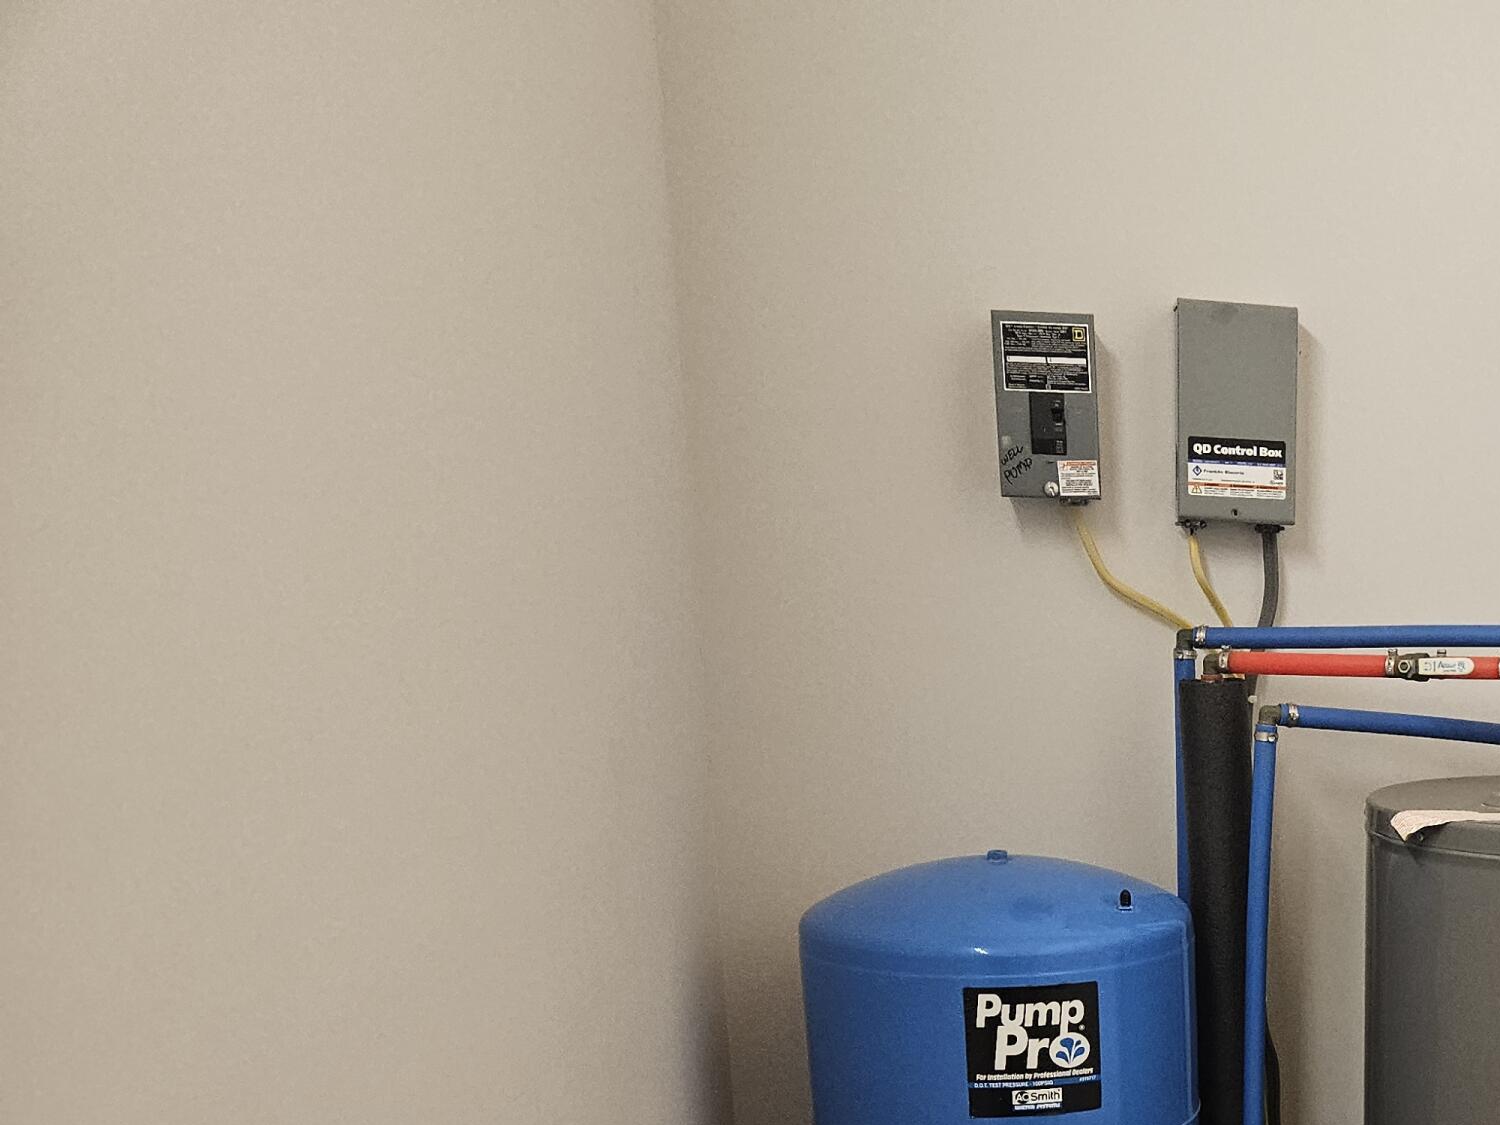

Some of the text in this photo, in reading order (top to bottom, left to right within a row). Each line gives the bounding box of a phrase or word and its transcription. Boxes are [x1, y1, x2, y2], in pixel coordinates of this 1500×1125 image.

[1193, 443, 1283, 458] QD Control Box
[1003, 458, 1033, 485] PUMP
[976, 993, 1085, 1035] Pump
[994, 1025, 1091, 1071] Pro
[987, 1073, 1024, 1081] Installation
[1034, 1070, 1072, 1079] Professional
[1030, 1089, 1061, 1102] Smith
